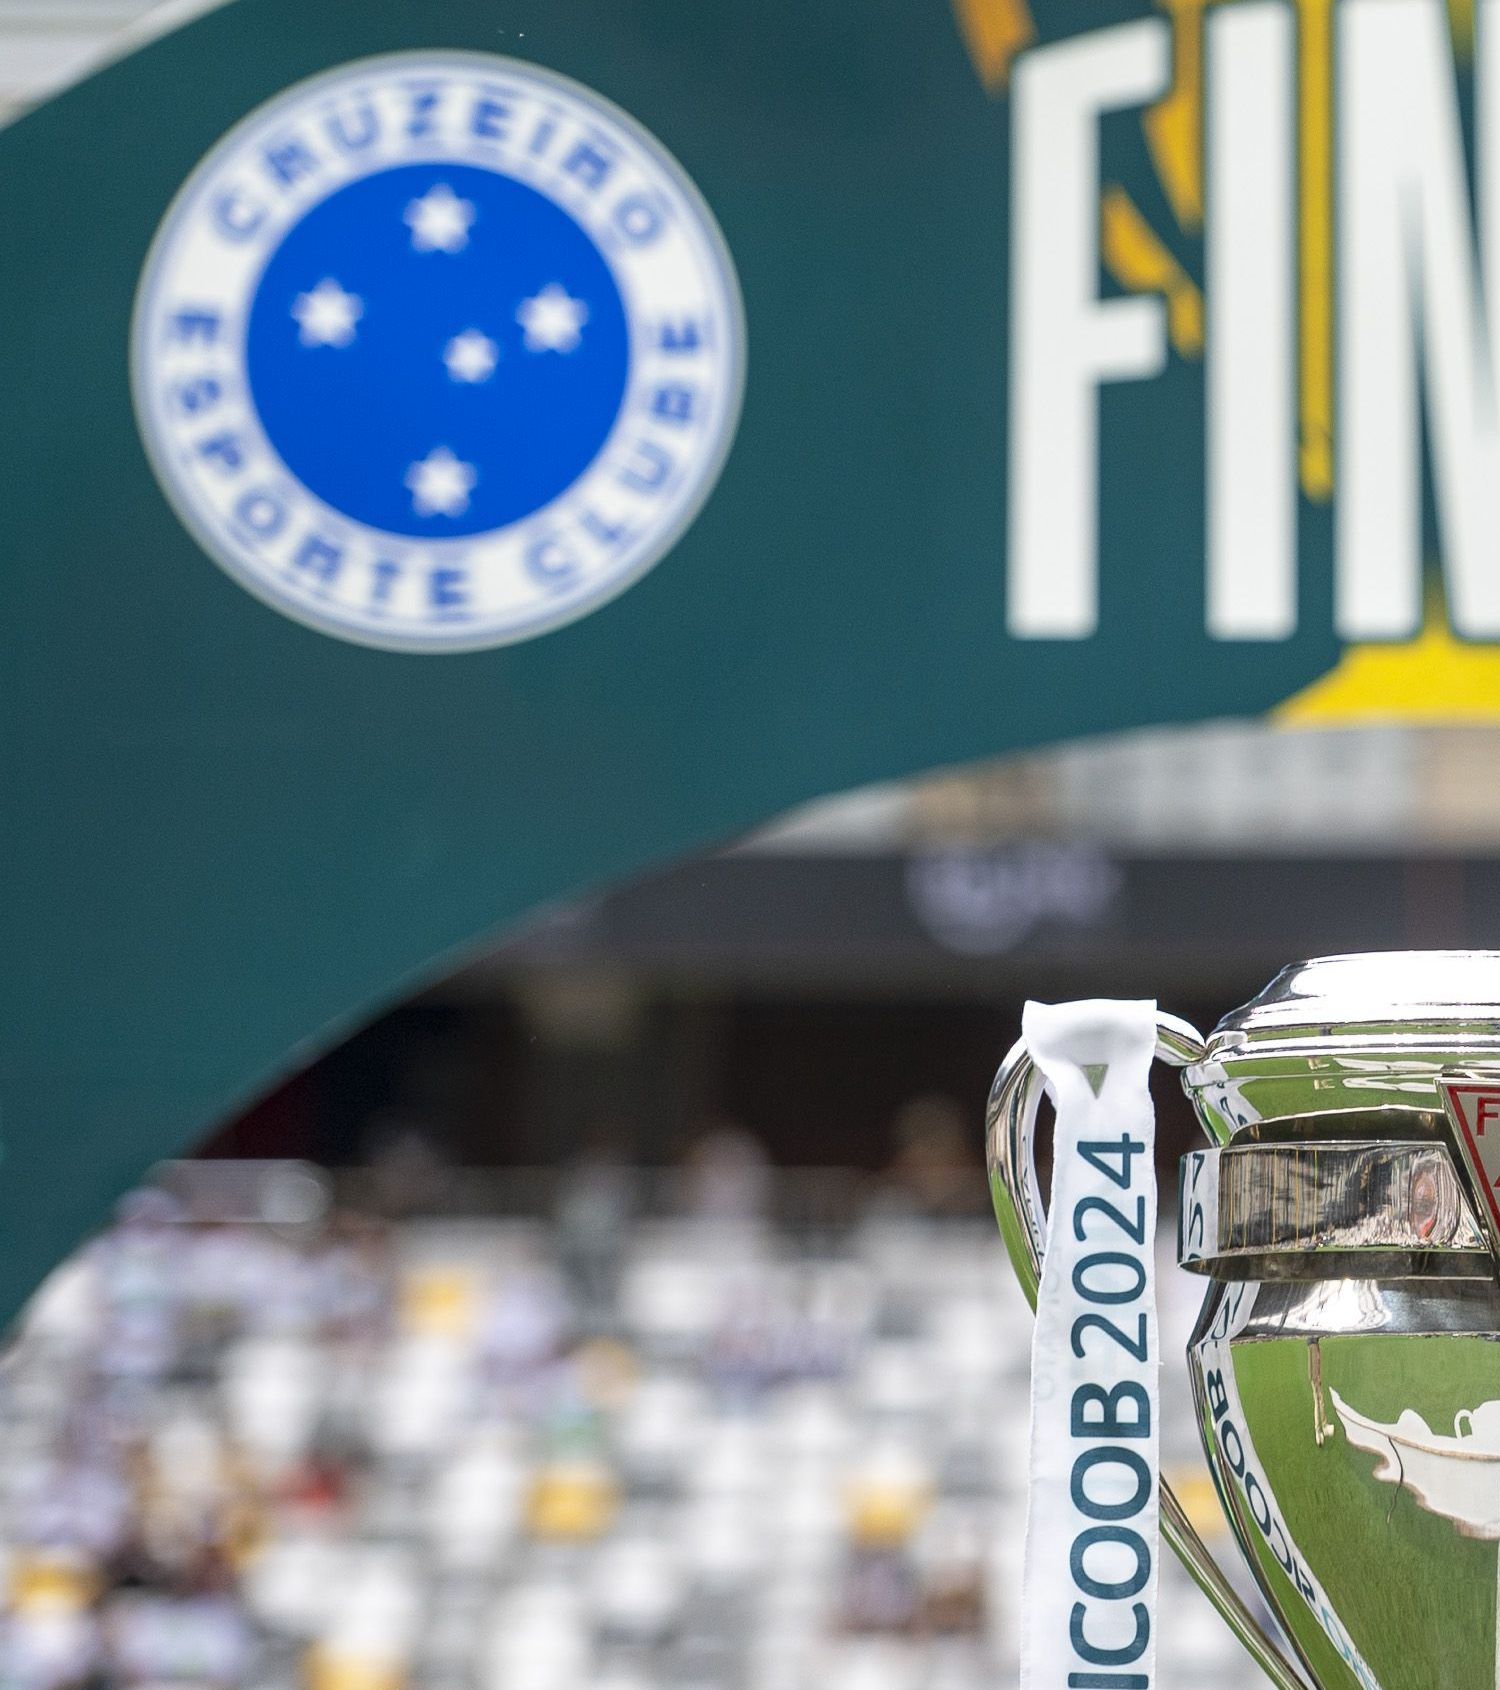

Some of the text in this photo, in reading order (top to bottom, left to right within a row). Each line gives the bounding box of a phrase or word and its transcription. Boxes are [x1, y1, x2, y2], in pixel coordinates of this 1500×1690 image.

[210, 92, 666, 247] CRUZEIRO
[172, 310, 704, 608] ESPORTE CLUBE
[1070, 1132, 1148, 1363] 2024
